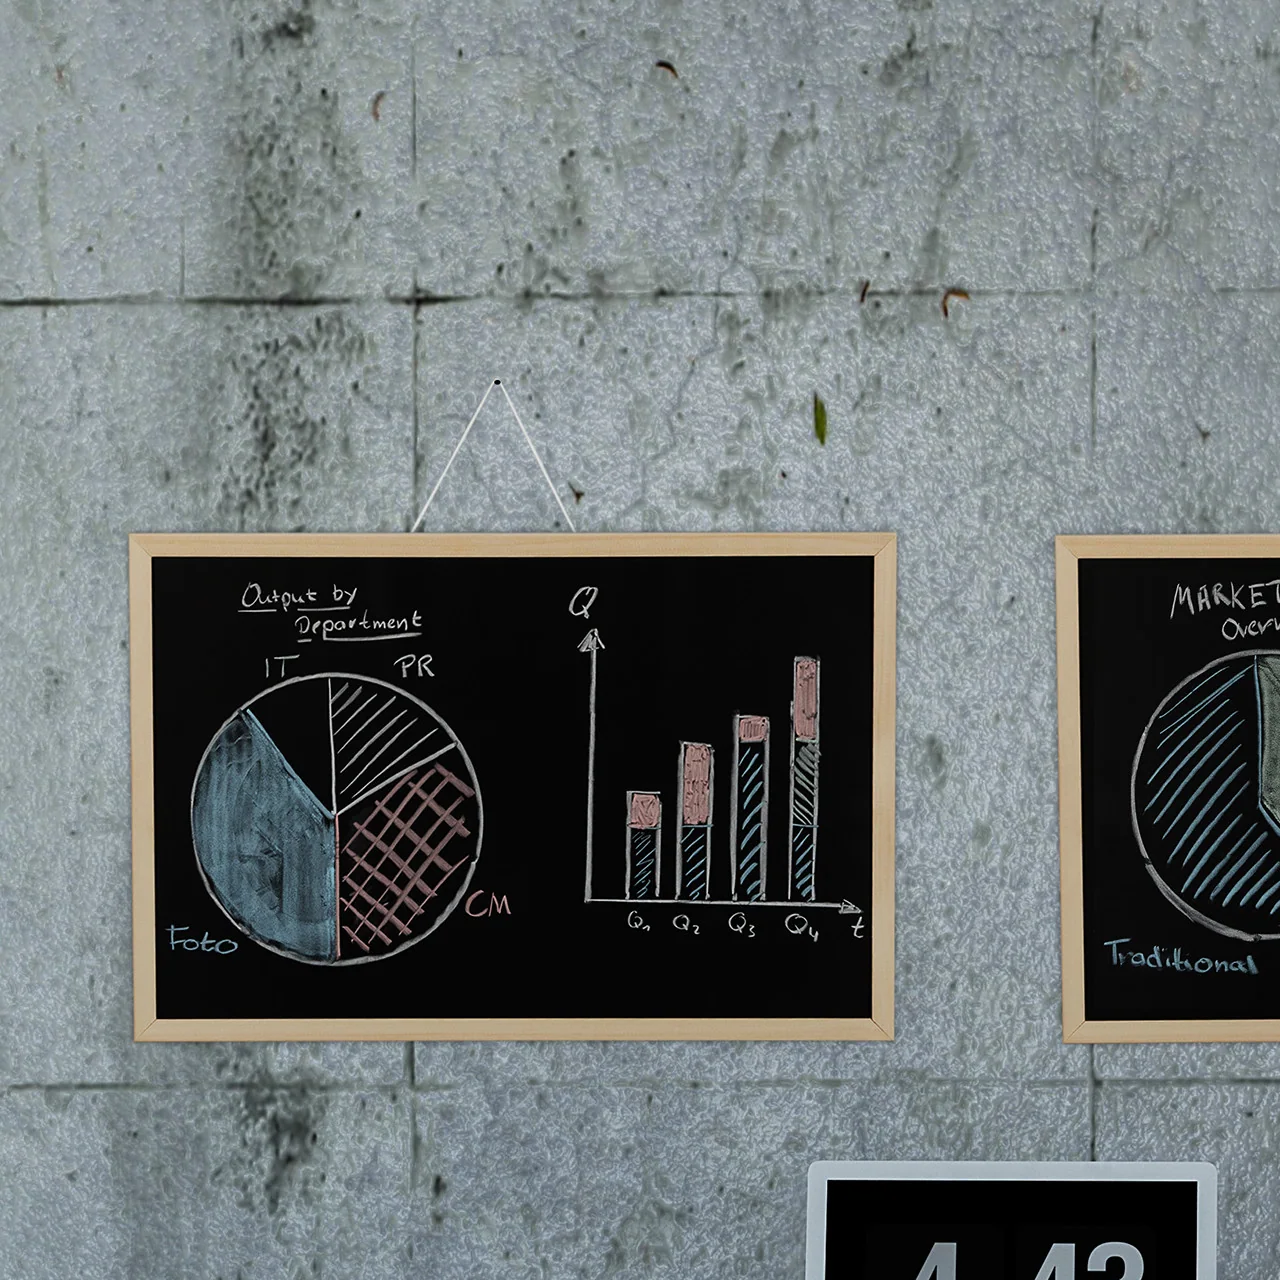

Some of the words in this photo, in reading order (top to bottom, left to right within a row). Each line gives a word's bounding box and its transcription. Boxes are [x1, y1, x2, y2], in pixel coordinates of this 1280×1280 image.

[240, 583, 316, 611] Output
[333, 584, 357, 605] by
[569, 586, 598, 619] Q
[295, 609, 422, 635] Department
[265, 655, 300, 678] IT
[394, 654, 434, 677] PR
[464, 890, 511, 917] CM
[165, 924, 239, 952] Foto
[1103, 938, 1258, 974] Traditional
